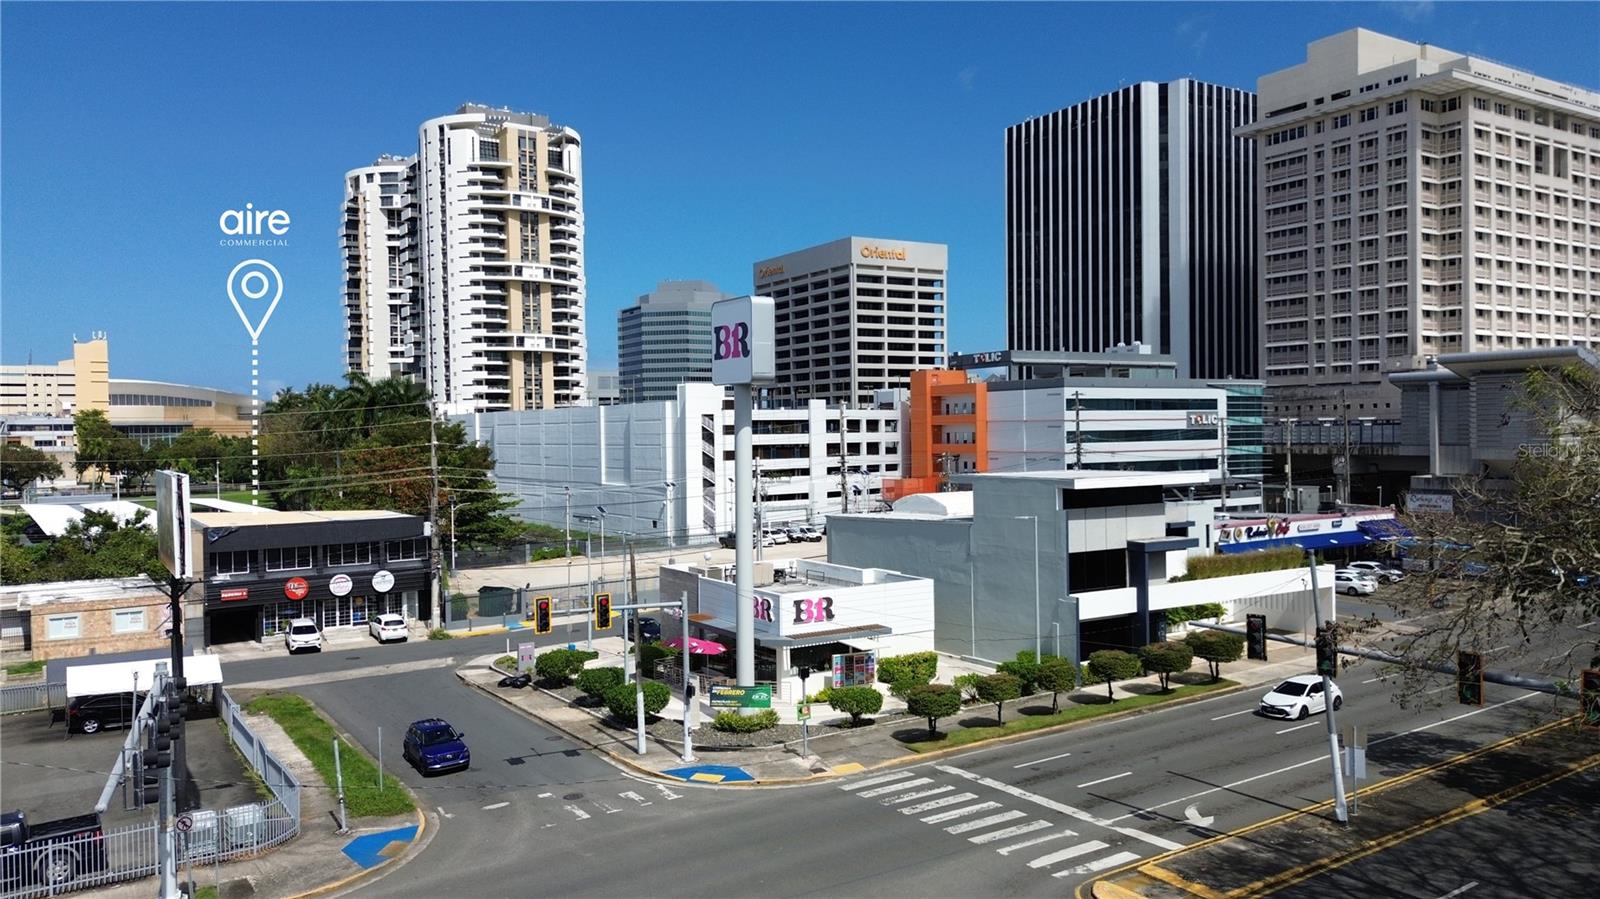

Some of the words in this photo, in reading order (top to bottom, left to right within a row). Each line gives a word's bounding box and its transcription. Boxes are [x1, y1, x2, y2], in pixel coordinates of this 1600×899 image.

[860, 246, 906, 261] Oriental
[714, 322, 750, 360] BR
[793, 597, 835, 625] BR
